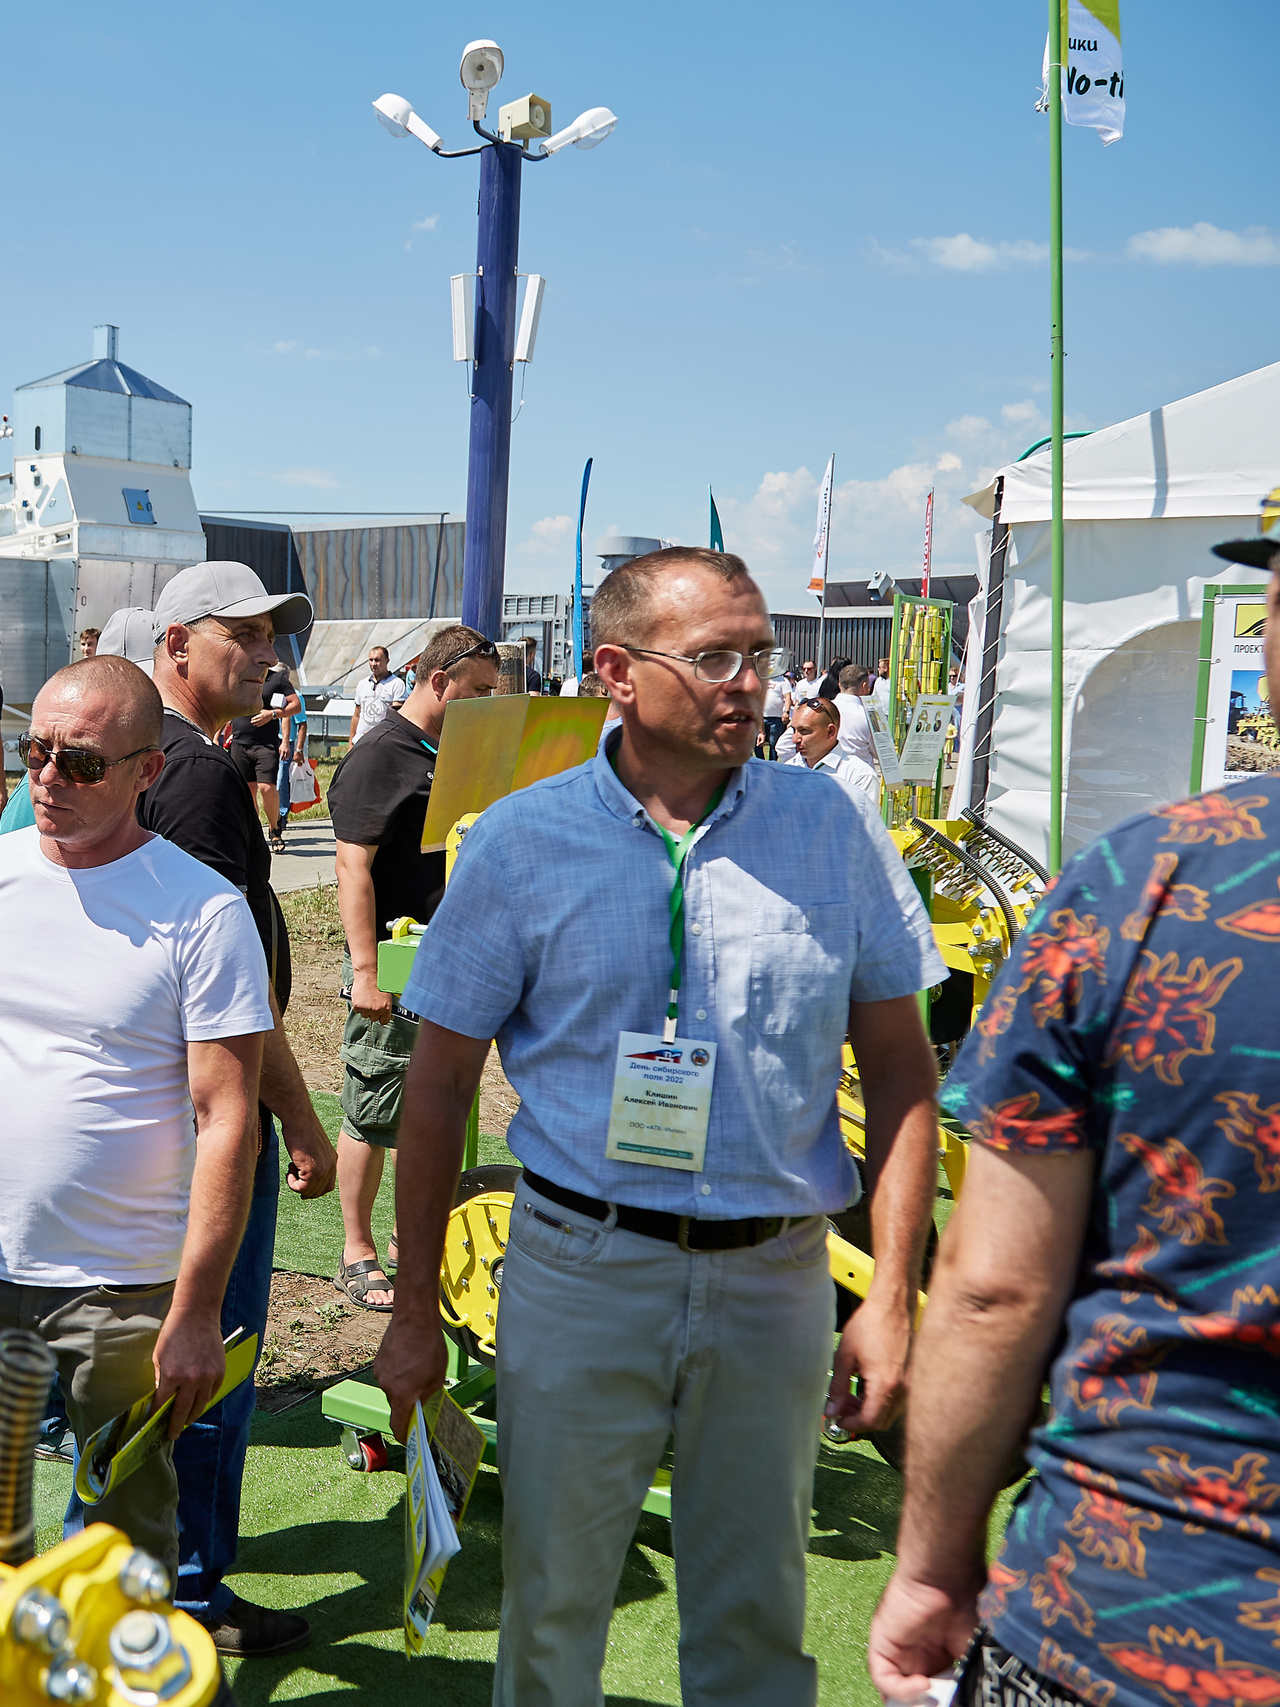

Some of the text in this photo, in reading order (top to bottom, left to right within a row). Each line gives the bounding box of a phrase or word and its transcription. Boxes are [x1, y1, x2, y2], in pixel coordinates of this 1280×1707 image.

[629, 1062, 699, 1077] День сибирского
[643, 1073, 684, 1084] поля 2022
[645, 1090, 678, 1100] Клишин
[624, 1096, 699, 1111] Алексей Иванович
[629, 1121, 645, 1129] ООО
